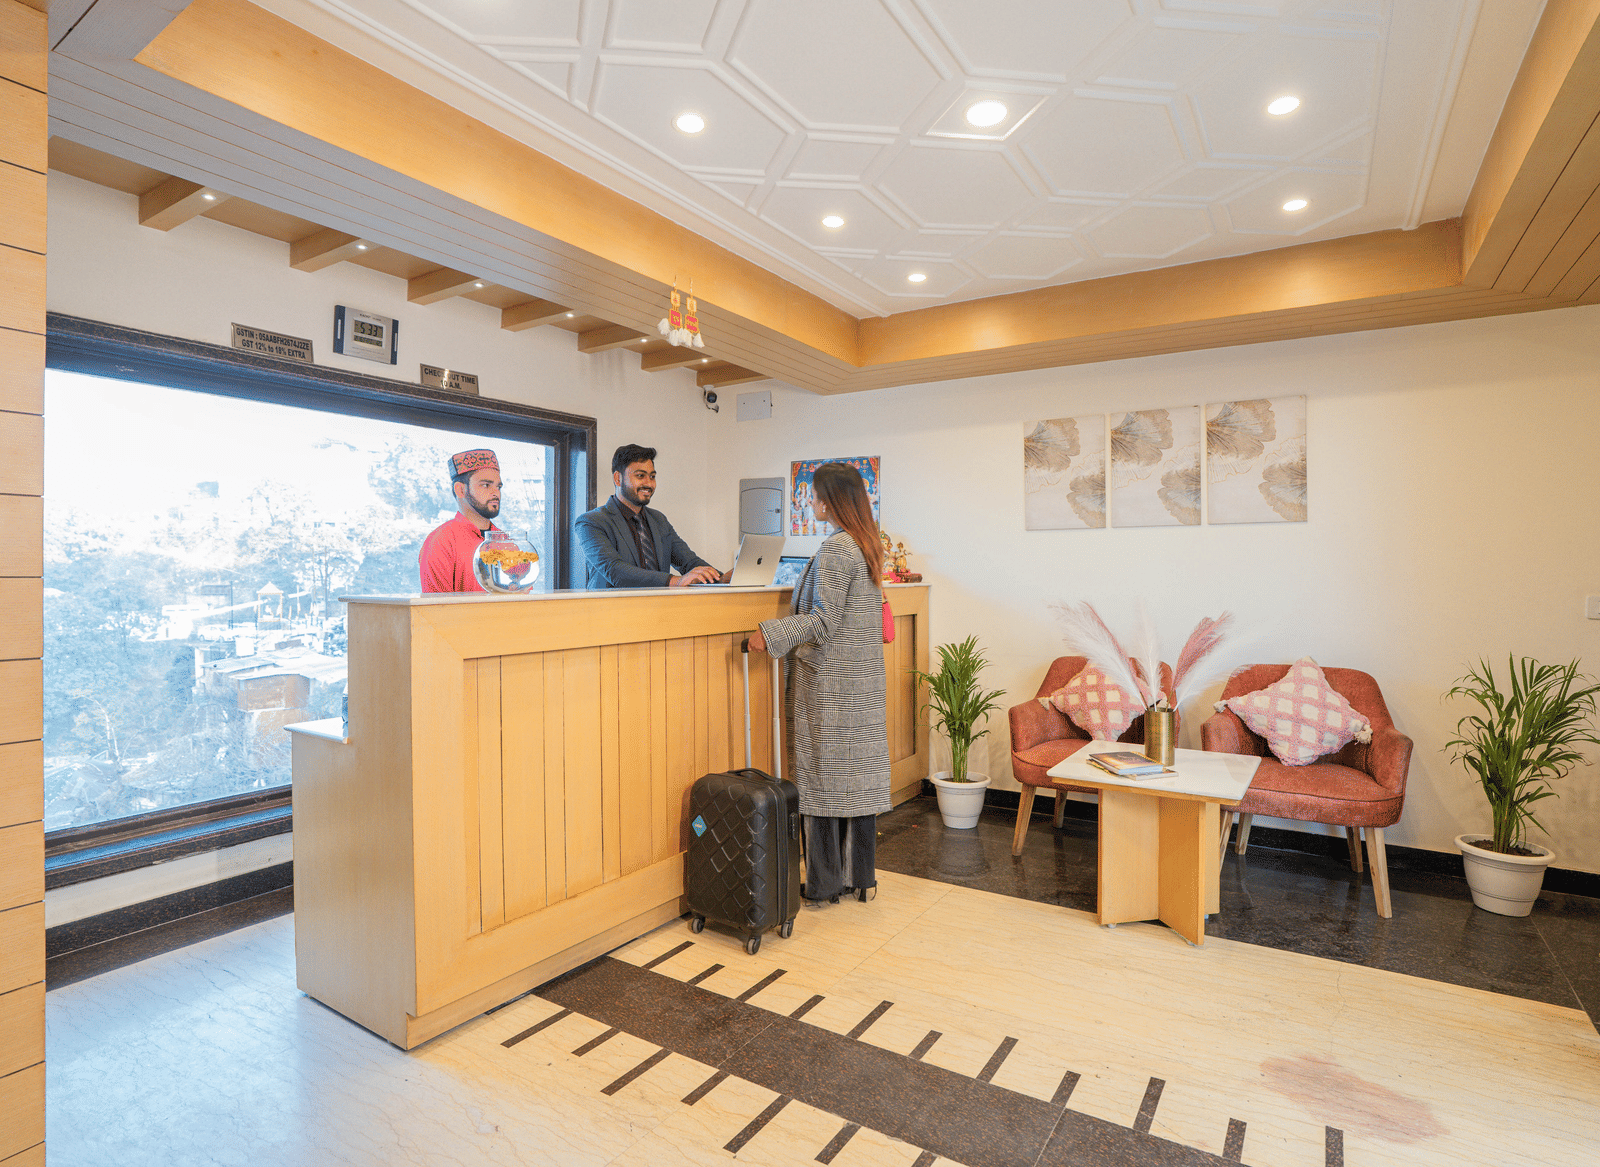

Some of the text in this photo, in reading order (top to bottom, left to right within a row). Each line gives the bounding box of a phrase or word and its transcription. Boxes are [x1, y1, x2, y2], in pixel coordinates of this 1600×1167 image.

[236, 327, 255, 339] GSTIN
[241, 338, 254, 348] GST
[255, 341, 267, 351] 12%
[267, 344, 274, 353] to
[287, 348, 306, 359] EXTRA
[460, 375, 476, 385] TIME
